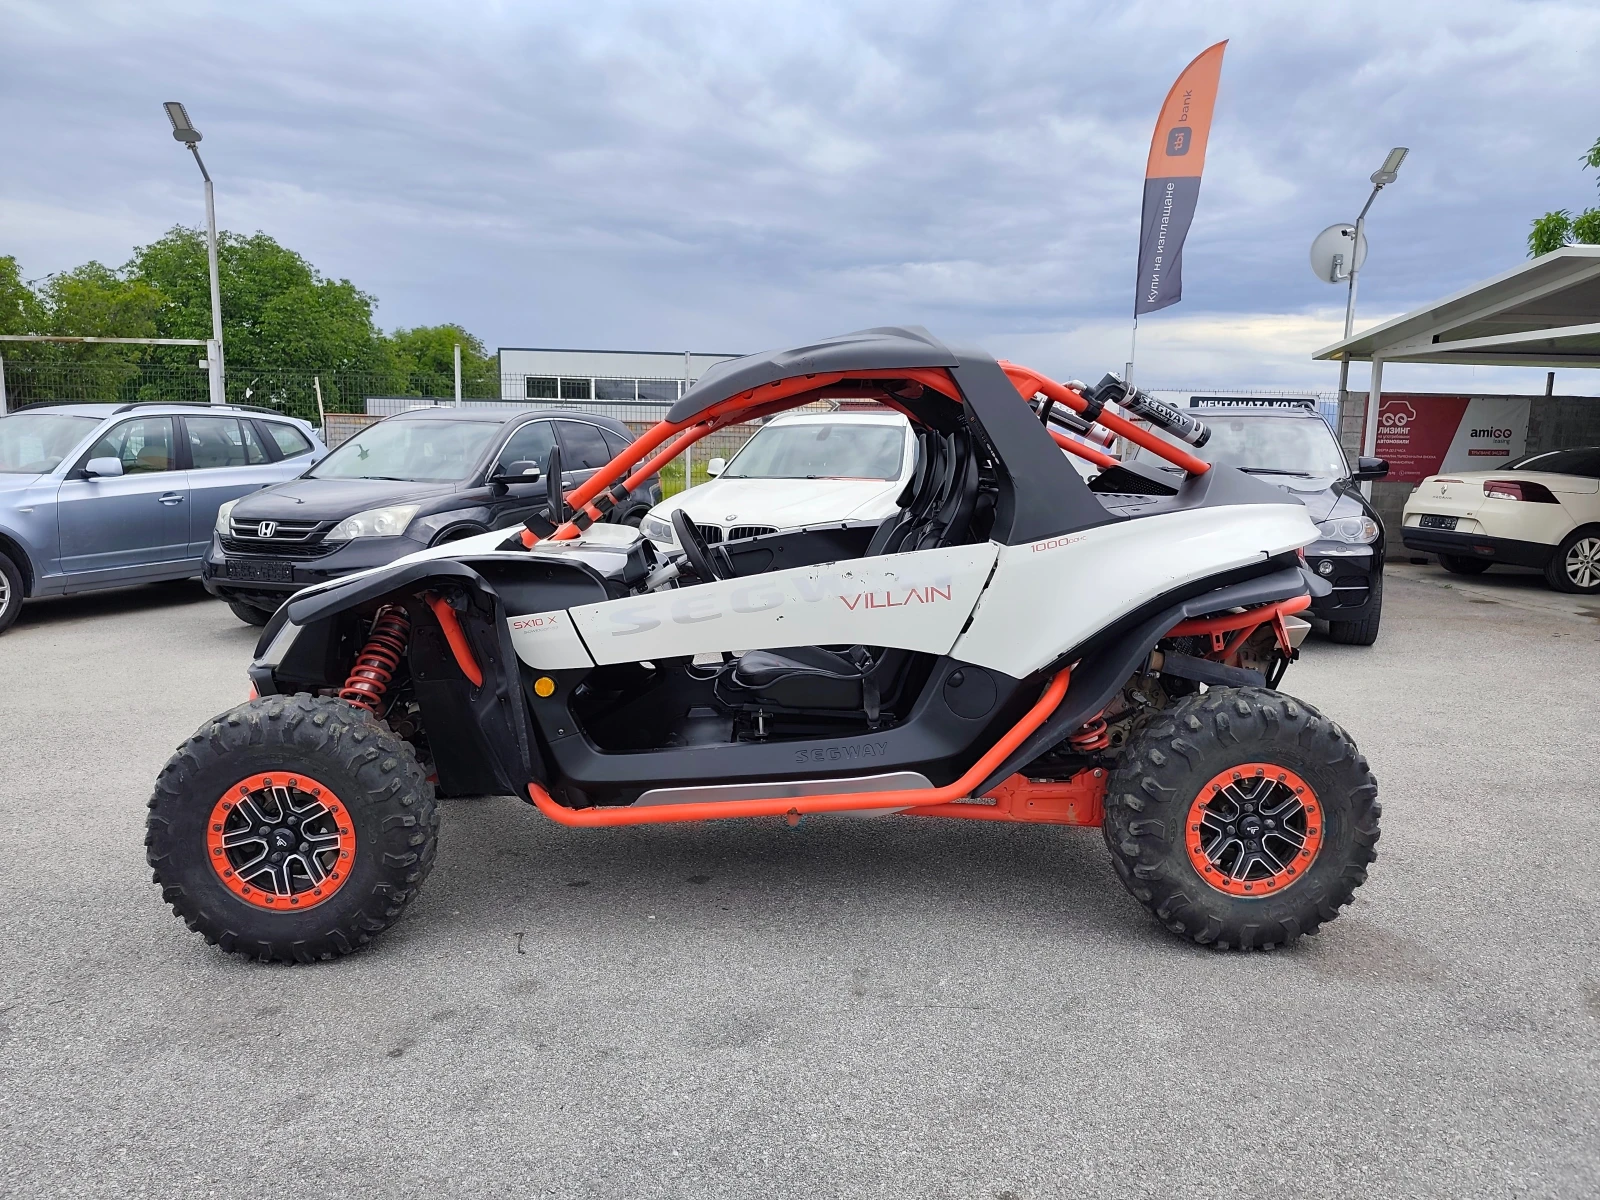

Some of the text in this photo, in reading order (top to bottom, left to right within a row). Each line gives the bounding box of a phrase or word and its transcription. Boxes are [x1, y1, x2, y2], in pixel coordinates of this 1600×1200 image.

[1174, 89, 1193, 151] tbi bank
[1147, 182, 1175, 303] Купи на изплащане
[1138, 394, 1190, 427] SEGWAY
[609, 566, 952, 637] SEGW
[839, 584, 952, 611] VILLAIN
[513, 615, 558, 630] SX10 X
[795, 741, 888, 764] SEGWAY
